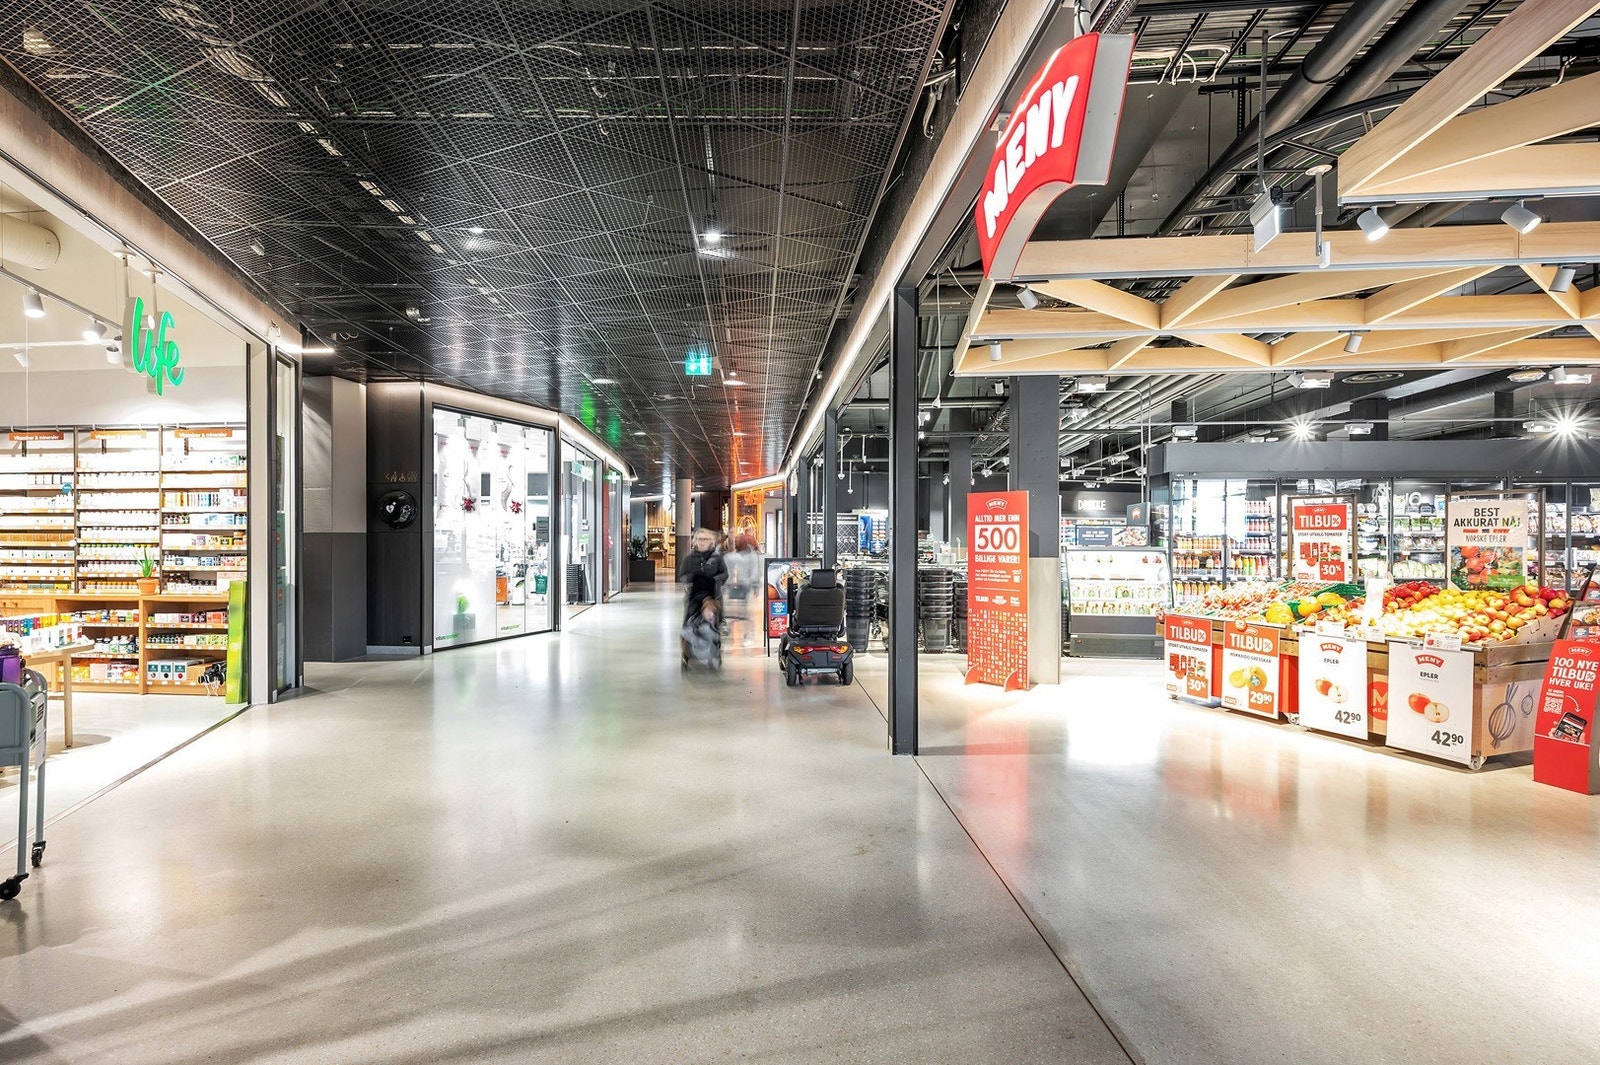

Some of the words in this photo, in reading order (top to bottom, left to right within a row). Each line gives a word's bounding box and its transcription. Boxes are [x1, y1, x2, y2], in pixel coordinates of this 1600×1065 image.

[983, 74, 1080, 239] MENY
[131, 296, 185, 396] life
[975, 514, 993, 523] ALLTID
[994, 514, 1007, 523] MER
[1007, 514, 1020, 523] ENN
[1474, 508, 1500, 517] BEST
[1298, 514, 1342, 528] TILBUD
[1453, 517, 1499, 527] AKKURAT
[1502, 516, 1521, 527] NÅ!
[977, 527, 1017, 550] 500
[975, 554, 997, 563] BILLIGE
[998, 554, 1020, 565] VARER!
[1170, 625, 1207, 643] TILBUD
[1229, 632, 1274, 653] TILBUD
[1322, 643, 1341, 652] MENY
[1323, 657, 1339, 665] EPLER
[1418, 656, 1441, 664] MENY
[1554, 656, 1575, 668] 100
[1577, 660, 1599, 671] NYE
[1420, 671, 1439, 680] EPLER
[1552, 666, 1597, 682] TILBUD
[1549, 677, 1571, 687] HVER
[1573, 681, 1594, 691] UKE!
